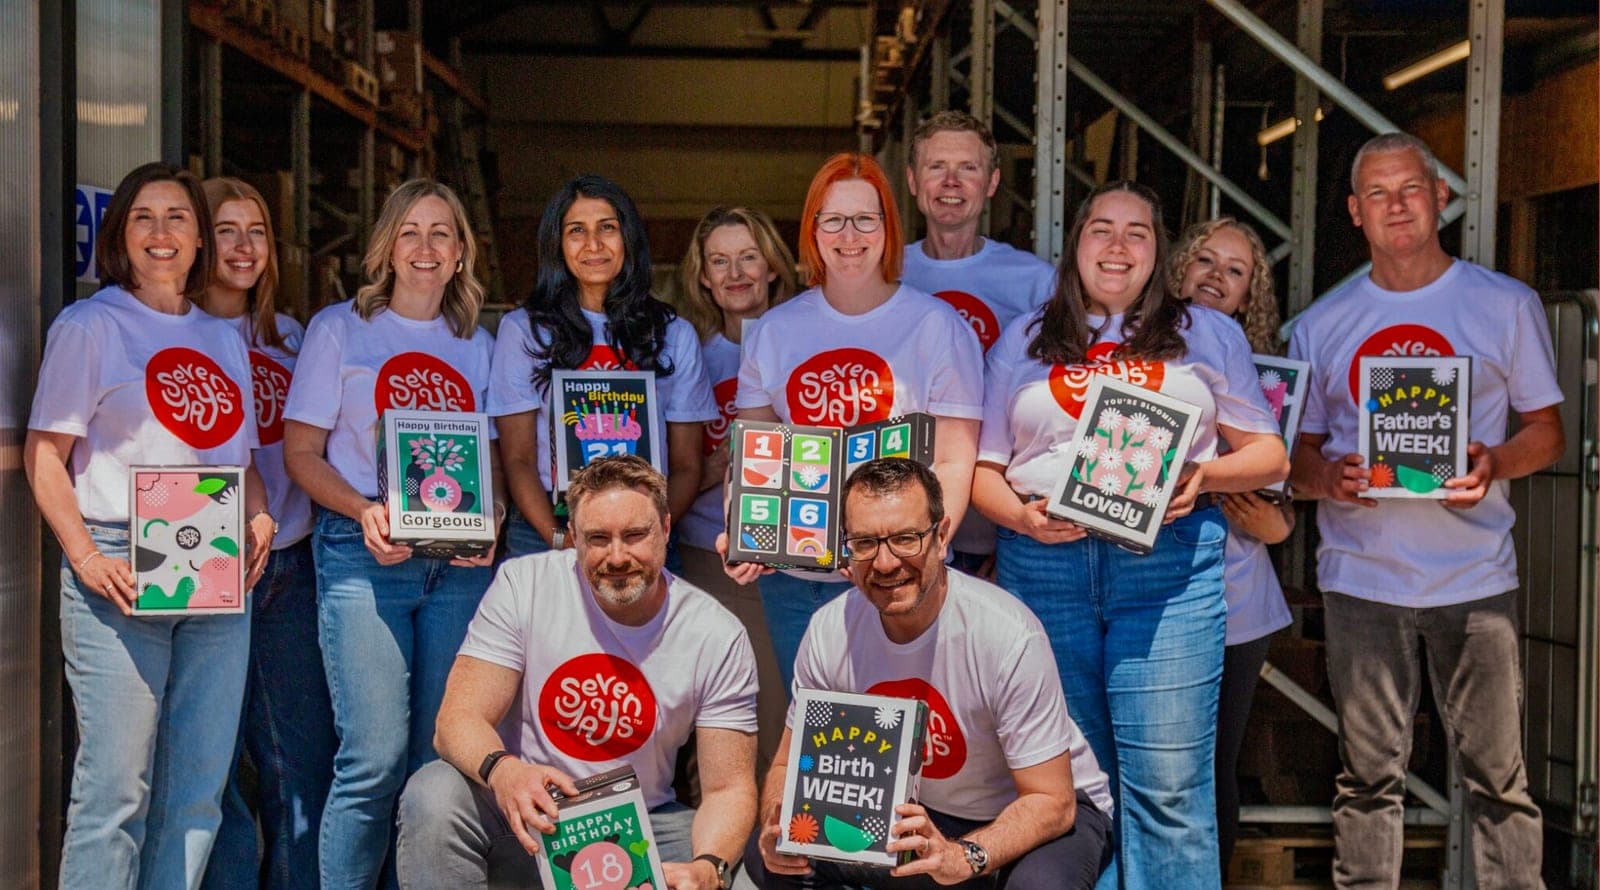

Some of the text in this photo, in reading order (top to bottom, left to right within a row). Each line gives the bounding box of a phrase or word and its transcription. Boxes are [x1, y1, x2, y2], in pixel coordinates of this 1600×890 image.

[565, 382, 610, 393] Happy
[589, 391, 645, 404] Birthday
[1379, 385, 1450, 408] HAPPY
[397, 420, 478, 433] Happy Birthday
[1373, 411, 1452, 430] Father's
[754, 436, 773, 457] 1
[801, 440, 821, 461] 2
[853, 437, 869, 459] 3
[886, 431, 902, 451] 4
[1376, 432, 1450, 456] WEEK!
[750, 500, 770, 521] 5
[799, 503, 820, 525] 6
[1072, 483, 1143, 529] Lovely
[402, 513, 482, 529] Gorgeous
[812, 726, 892, 754] HAPPY
[818, 754, 875, 778] Birth
[803, 776, 885, 811] WEEK!
[551, 817, 633, 850] BIRTHDAY
[564, 812, 613, 834] HAPPY
[580, 853, 624, 889] 18
